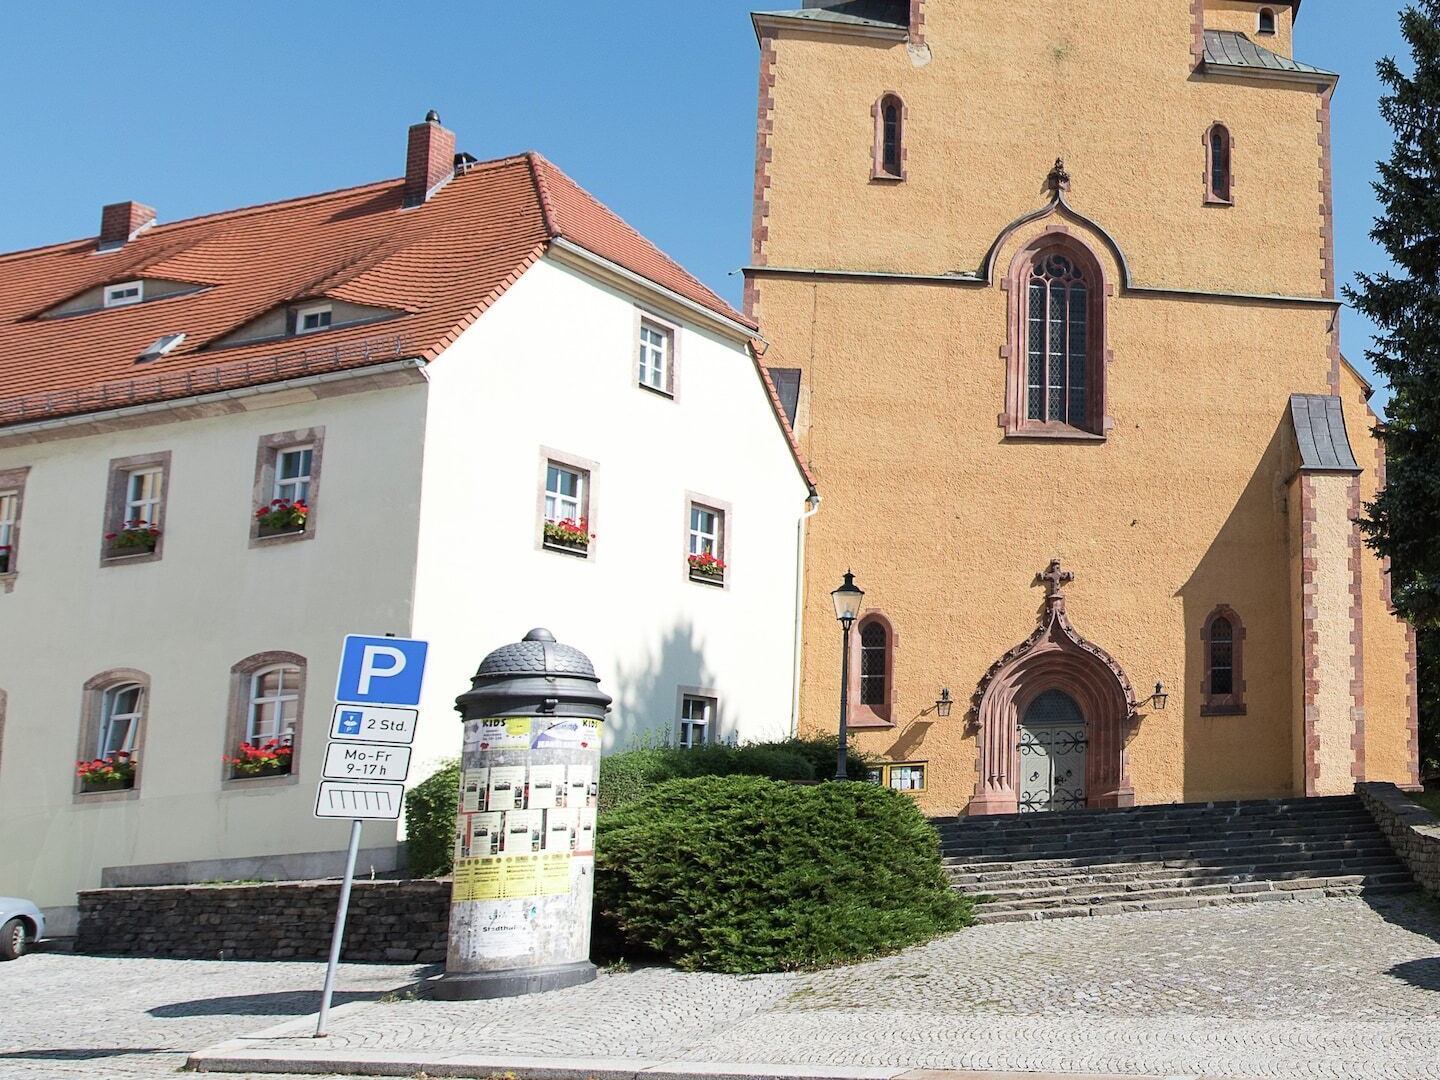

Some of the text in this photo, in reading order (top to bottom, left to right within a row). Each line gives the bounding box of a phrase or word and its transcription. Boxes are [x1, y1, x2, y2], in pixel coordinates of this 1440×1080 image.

[357, 645, 407, 695] P
[367, 718, 407, 732] 2 Std.
[482, 718, 506, 728] KIDS
[582, 719, 598, 729] KIDS
[344, 749, 392, 762] Mo-Fr
